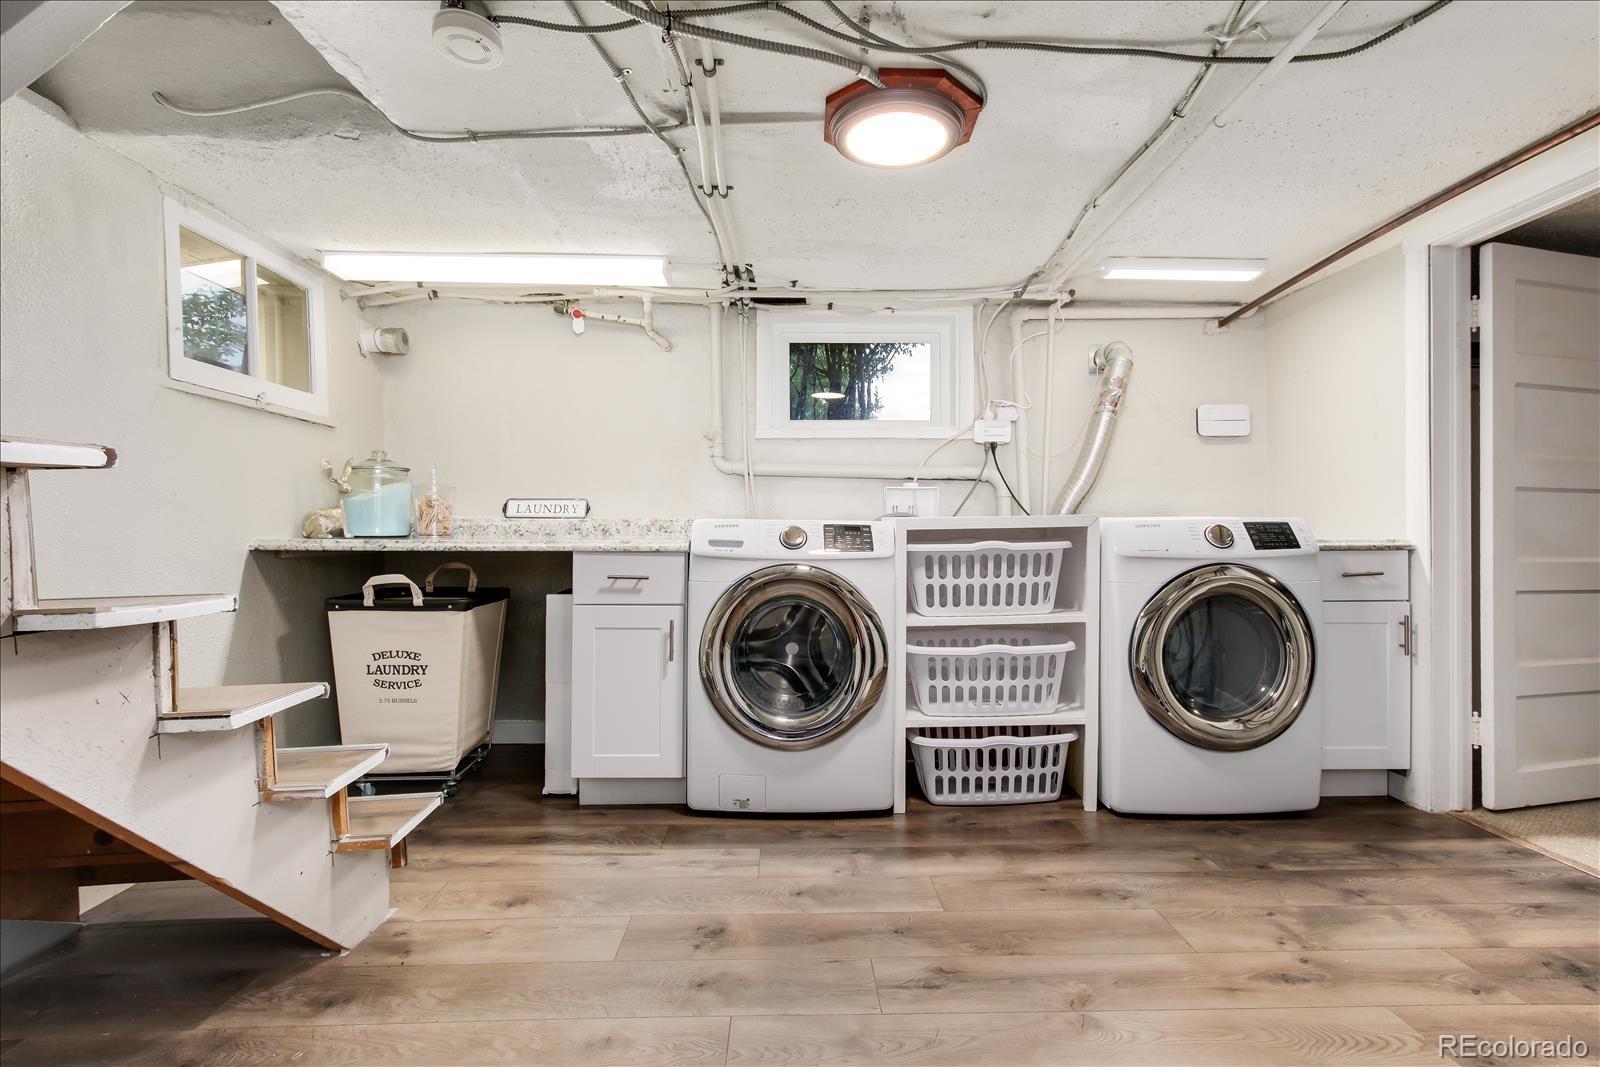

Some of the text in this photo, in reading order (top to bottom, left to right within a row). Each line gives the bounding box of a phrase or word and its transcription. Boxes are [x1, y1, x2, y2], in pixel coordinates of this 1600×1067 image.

[515, 503, 579, 514] LAUNDRY
[371, 650, 422, 661] DELUXE
[366, 664, 429, 675] LAUNDRY
[373, 679, 422, 690] SERVICE
